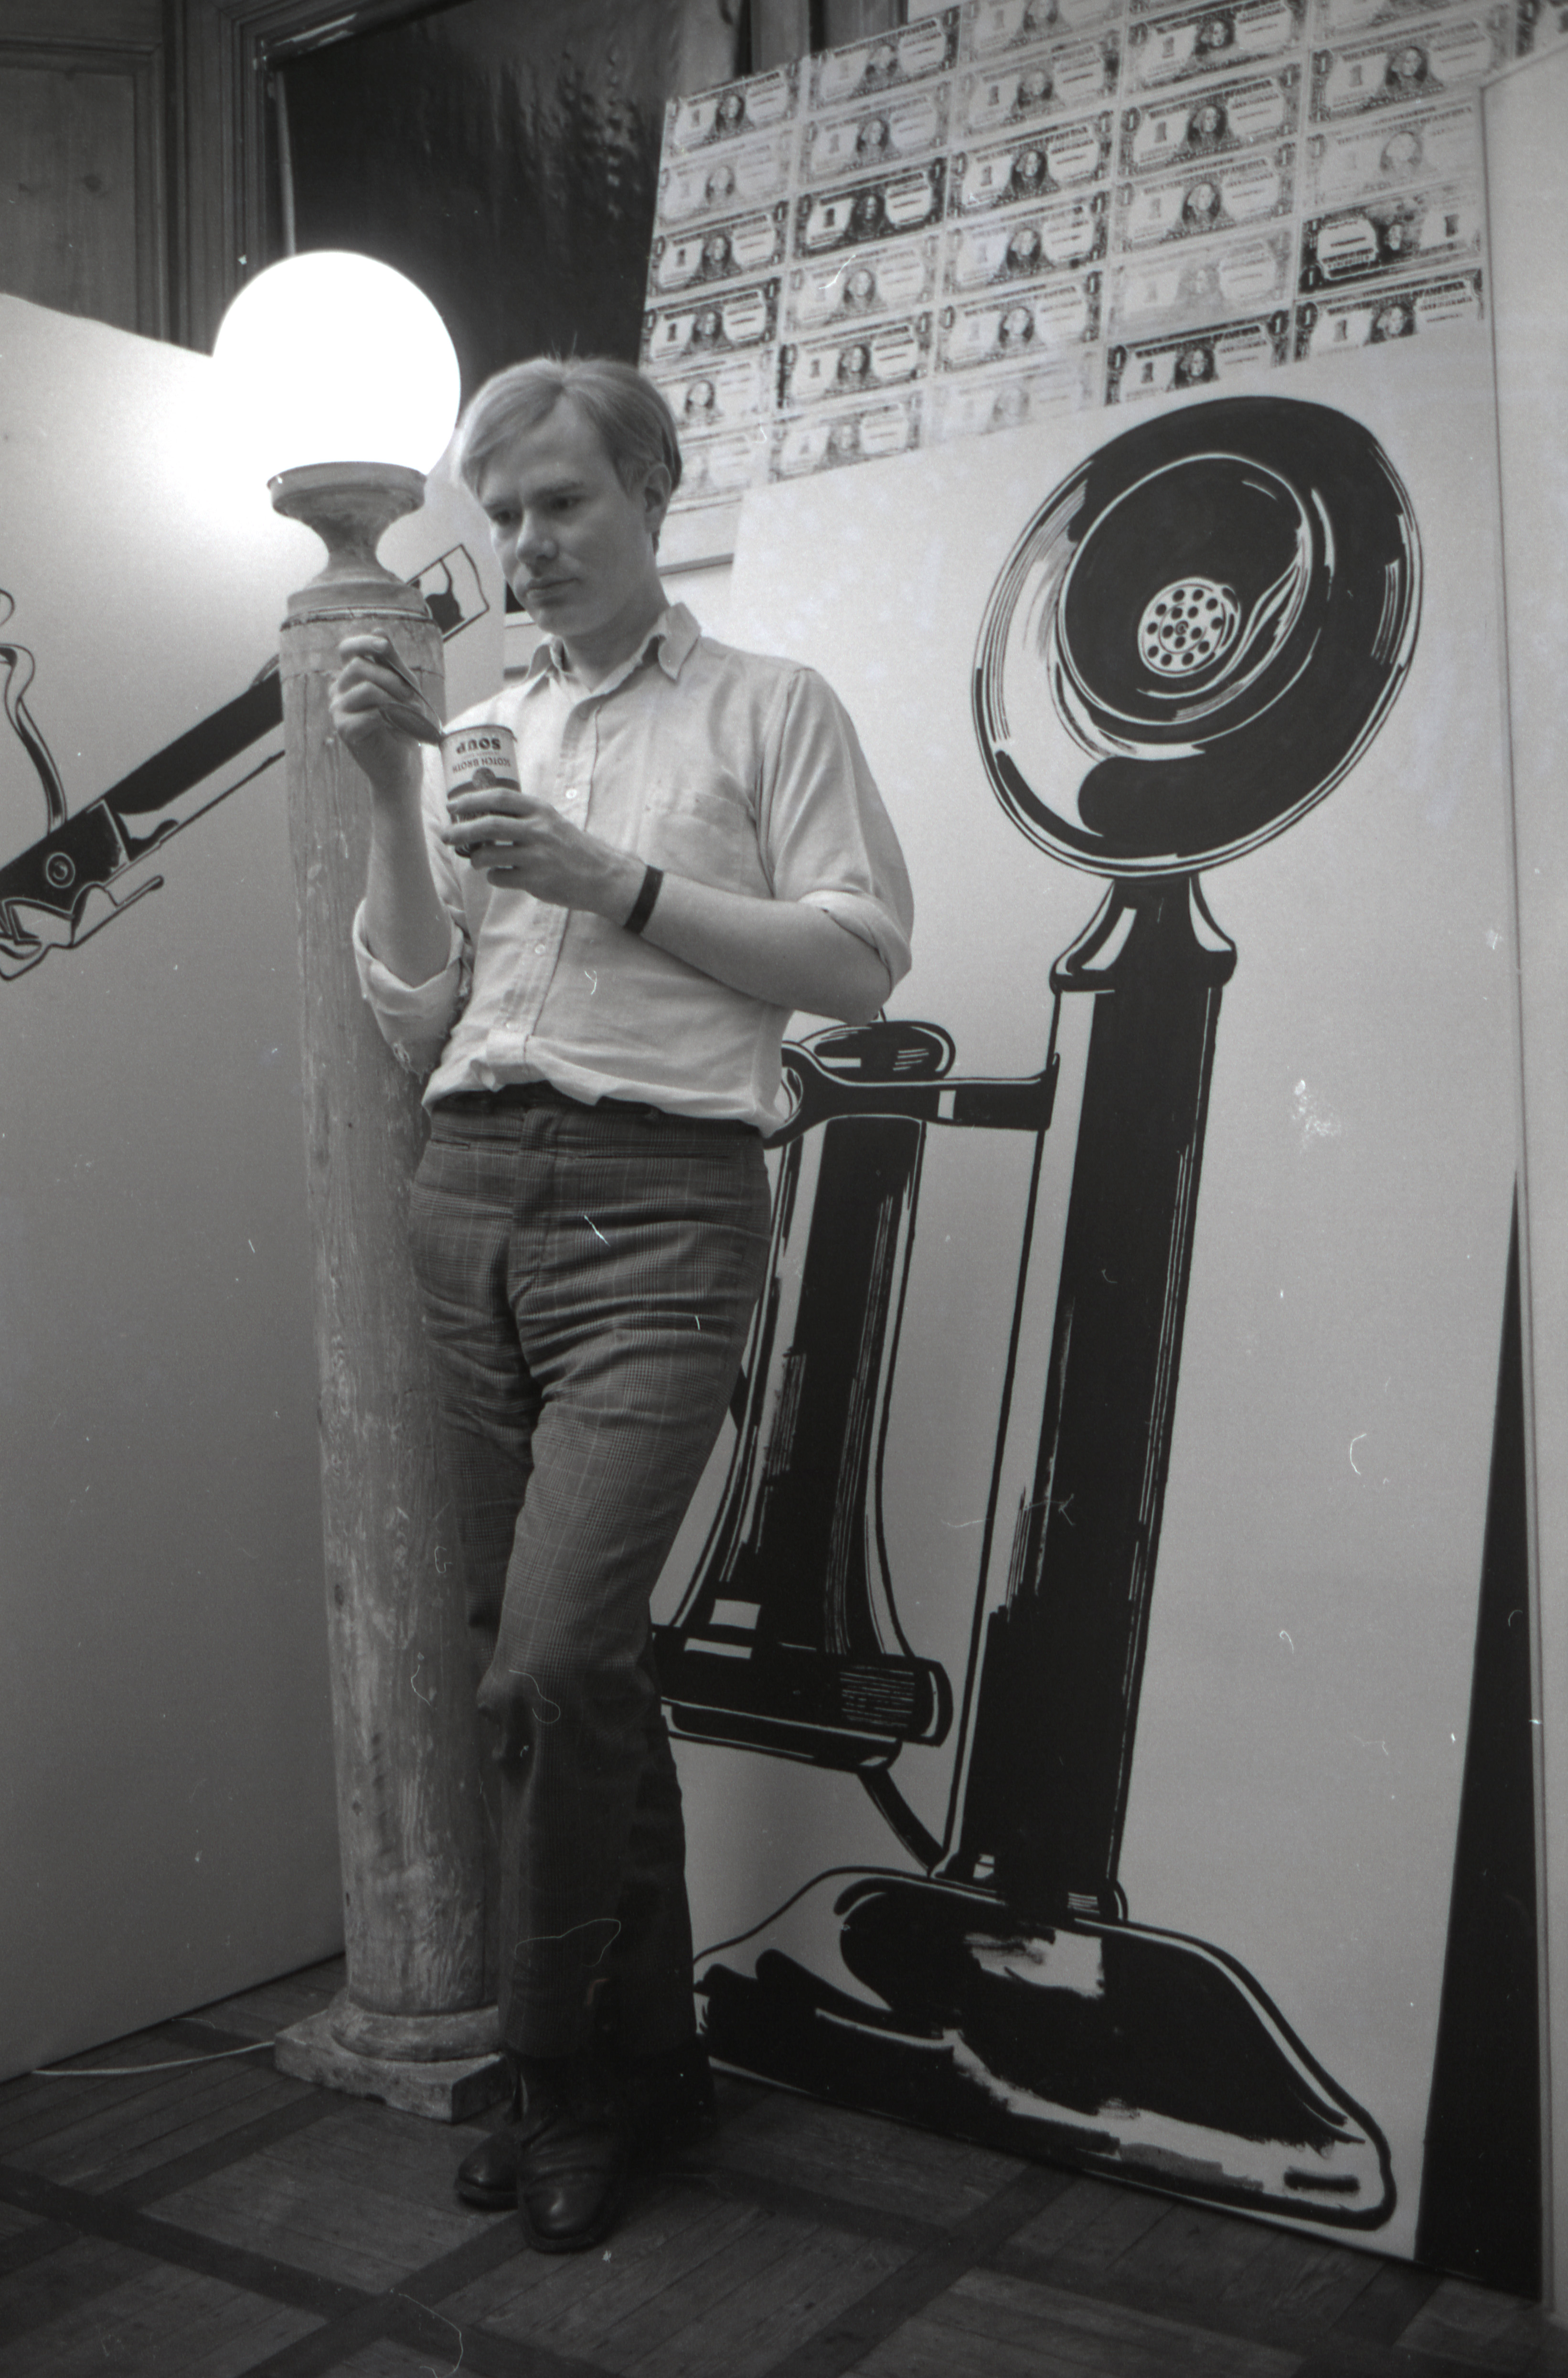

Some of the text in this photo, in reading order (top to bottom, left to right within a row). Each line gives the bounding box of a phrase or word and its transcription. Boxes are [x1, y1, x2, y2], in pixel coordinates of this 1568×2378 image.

[457, 738, 501, 754] SOUP
[453, 757, 511, 773] SCOTCH BROTH
